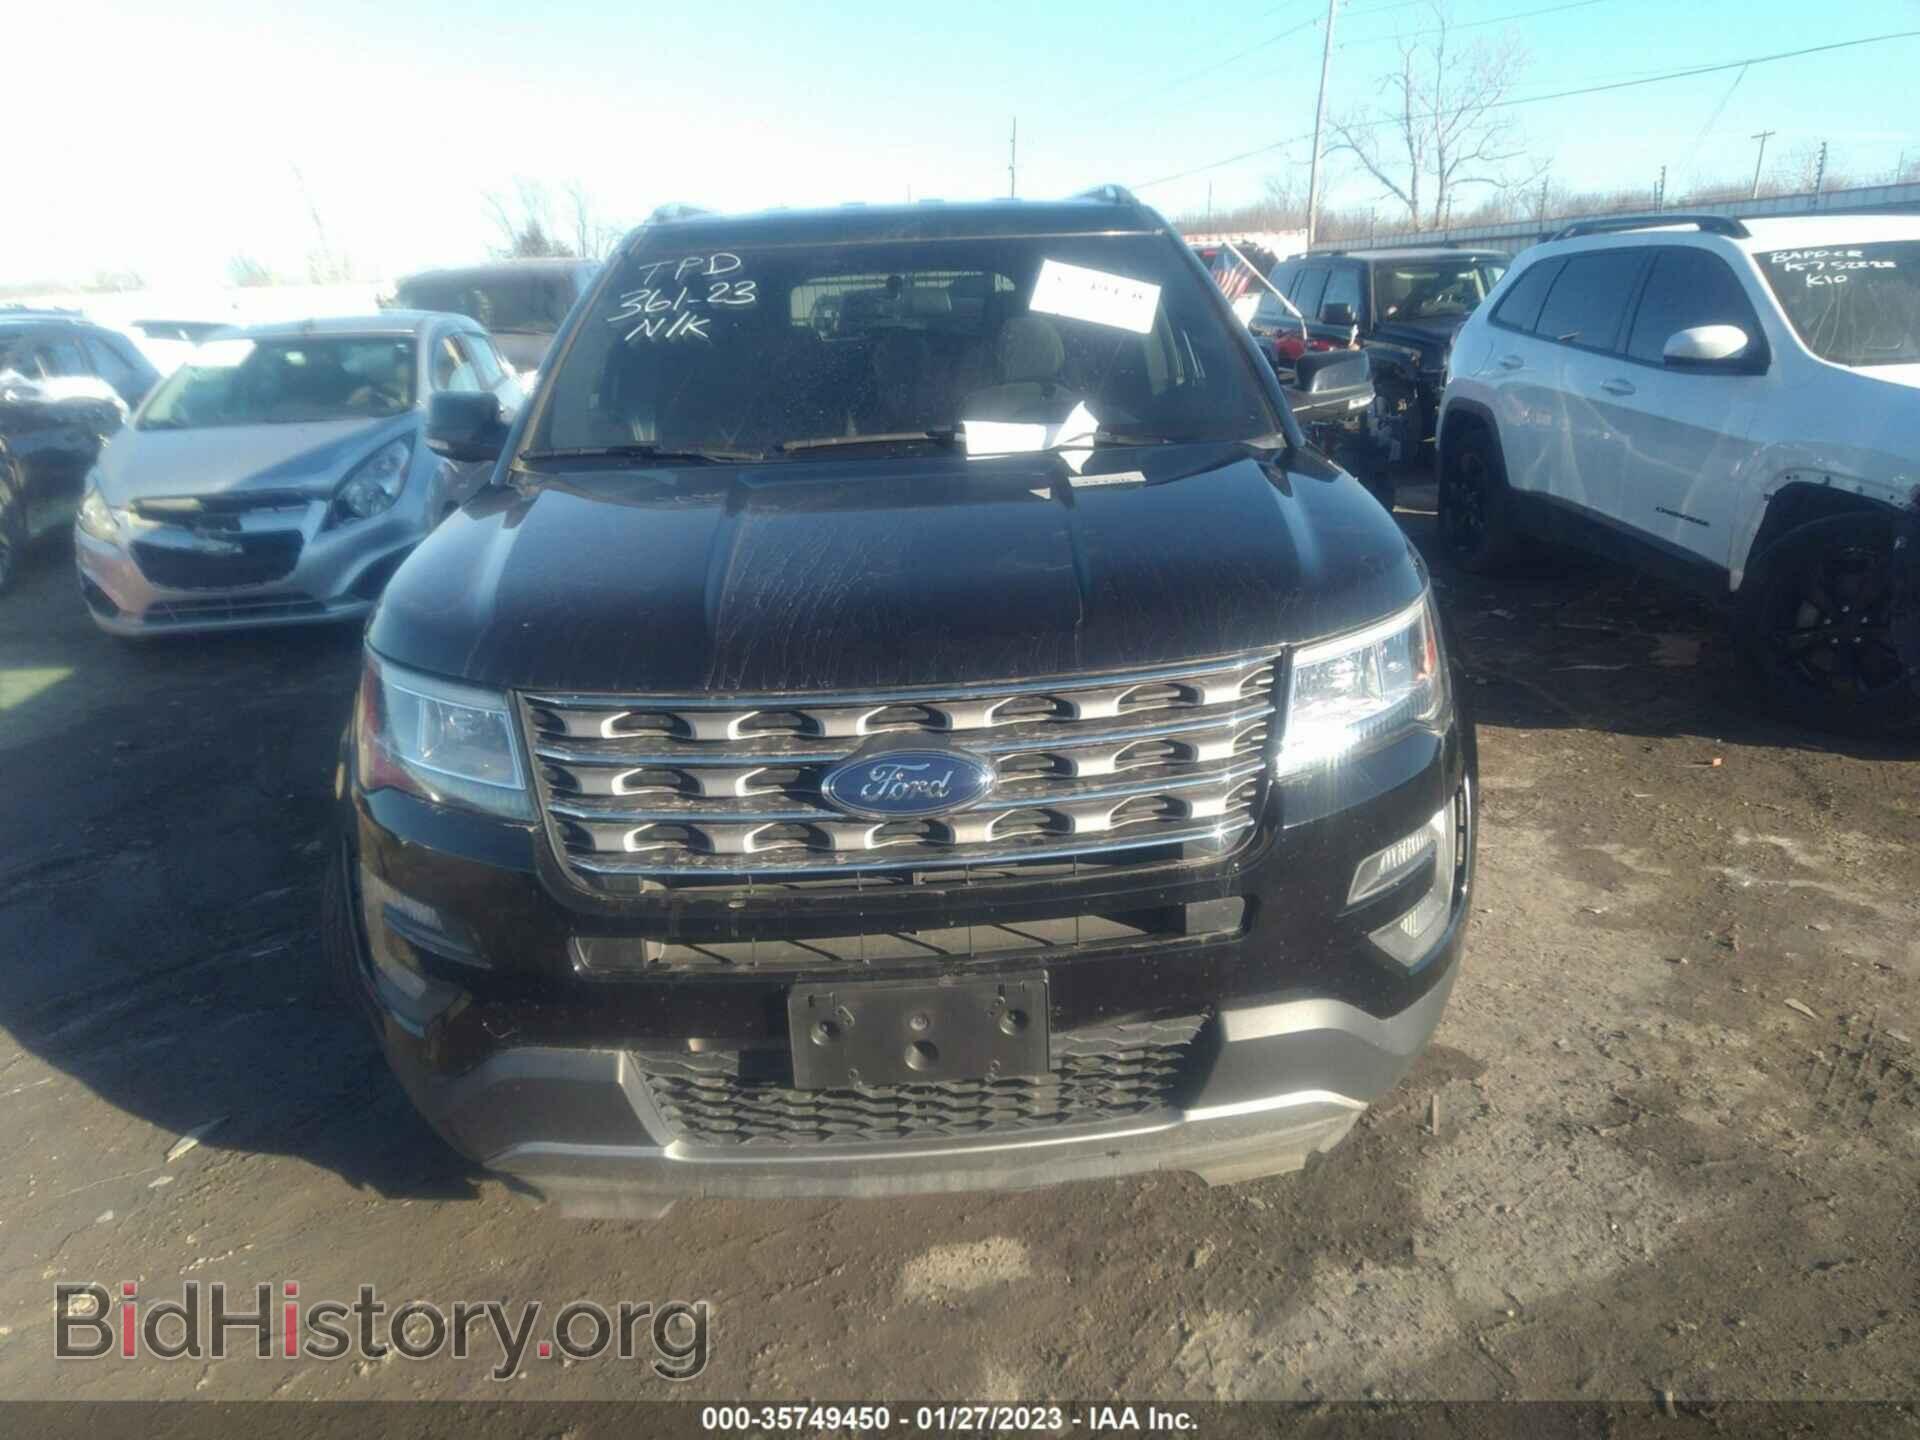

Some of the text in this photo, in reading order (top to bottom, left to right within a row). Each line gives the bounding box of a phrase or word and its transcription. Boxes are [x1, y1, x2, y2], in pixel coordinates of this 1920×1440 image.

[639, 252, 742, 285] TPD
[607, 280, 757, 322] 361-23
[860, 762, 954, 801] Ford
